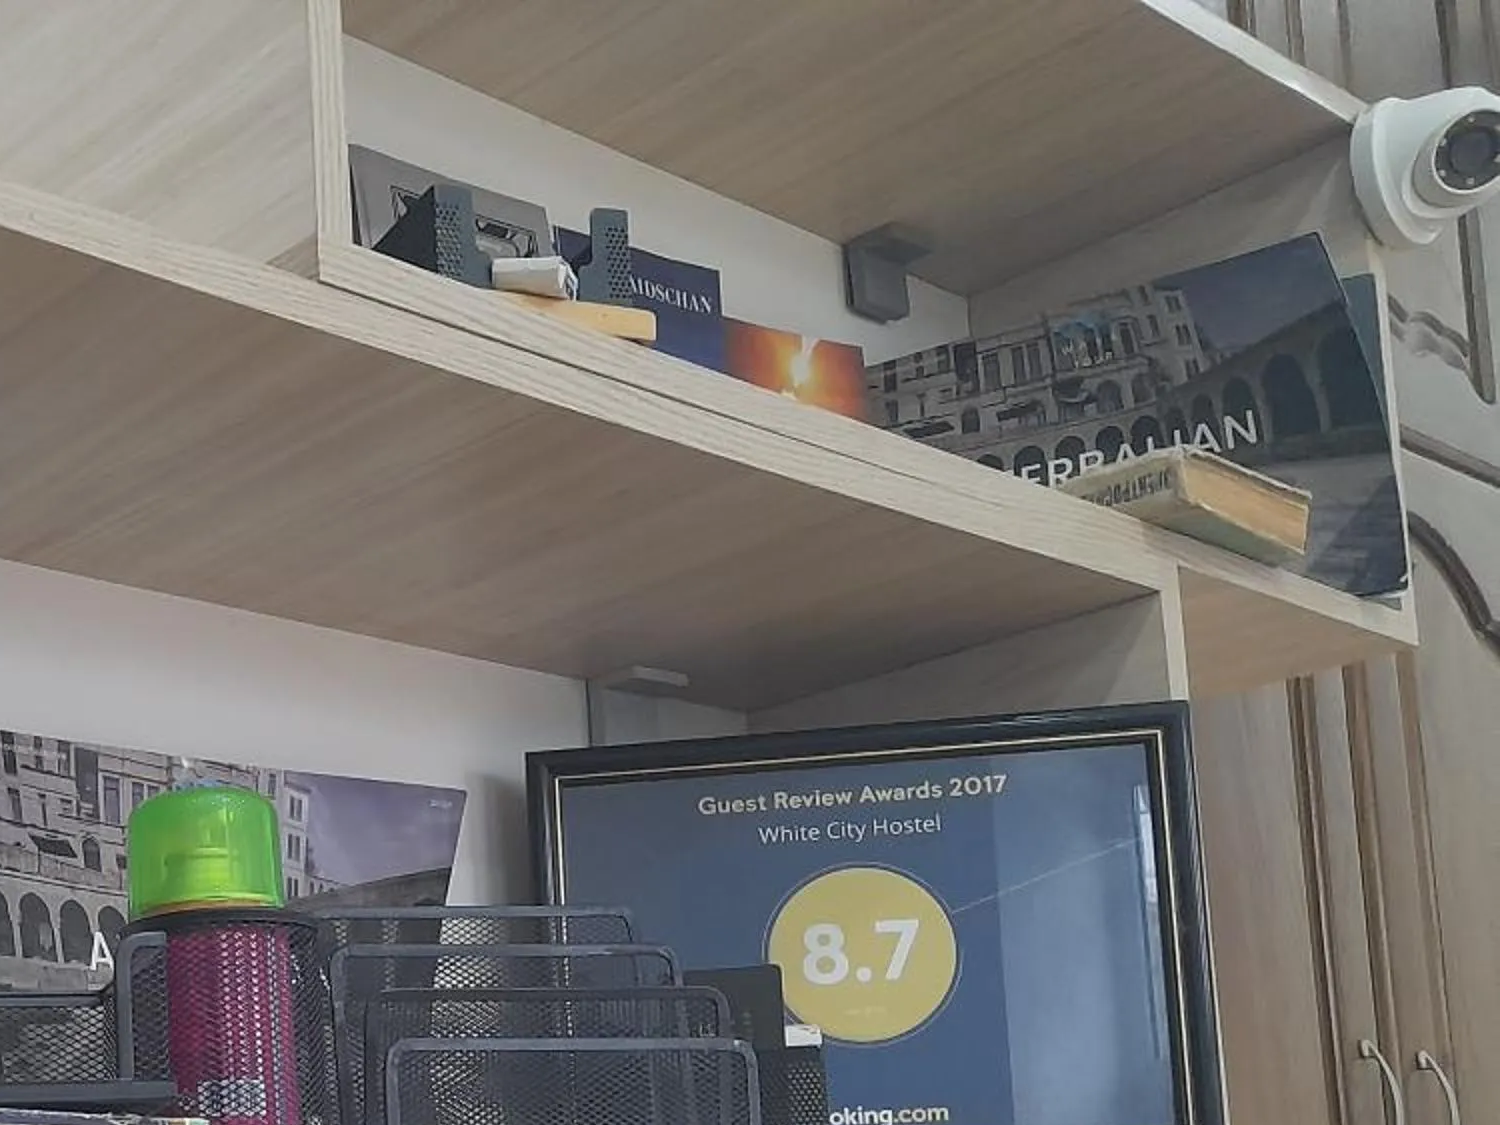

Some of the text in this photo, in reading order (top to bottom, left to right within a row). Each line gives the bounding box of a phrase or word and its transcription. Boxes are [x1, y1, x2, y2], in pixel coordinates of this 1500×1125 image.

[698, 775, 1008, 816] Guest Review Awards 2017
[758, 813, 942, 845] White City Hostel
[802, 918, 920, 986] 8.7
